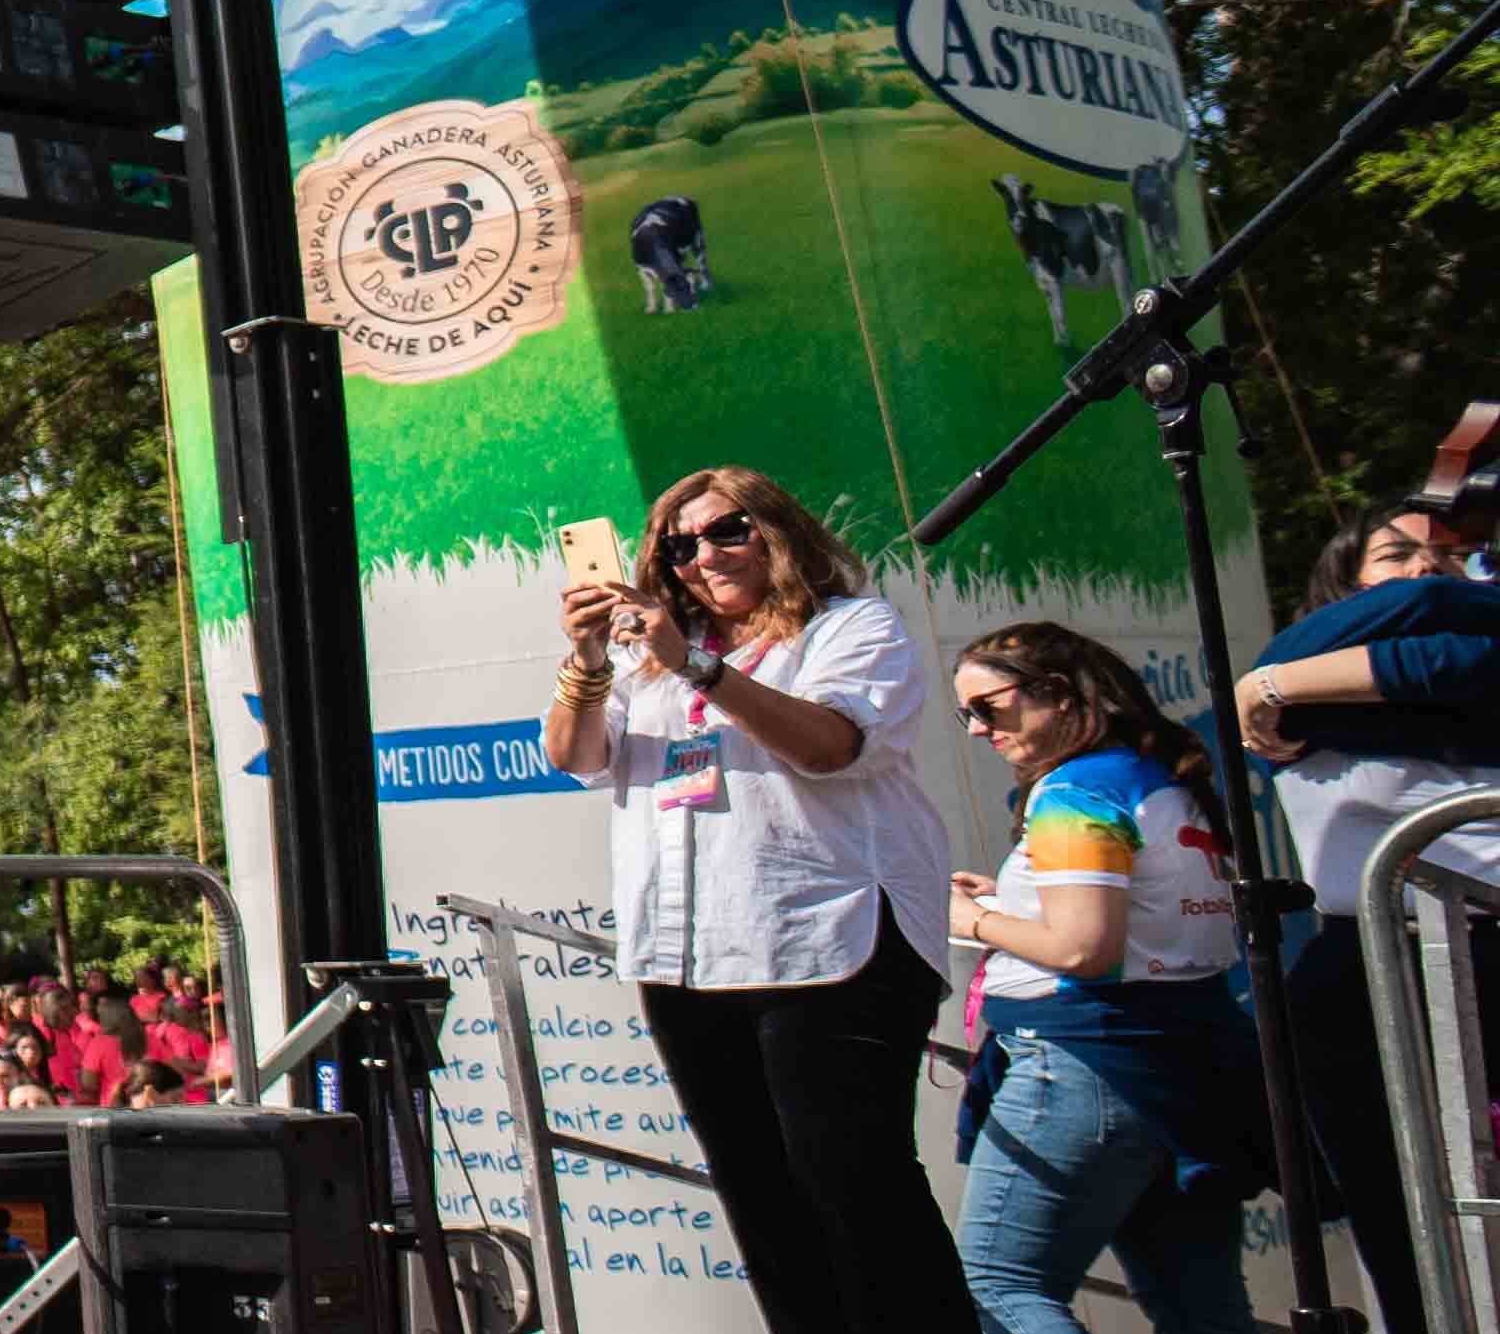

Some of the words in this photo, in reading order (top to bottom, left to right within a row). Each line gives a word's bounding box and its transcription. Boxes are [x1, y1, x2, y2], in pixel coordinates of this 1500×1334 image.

[307, 170, 357, 305] AGRUPACIÓN
[361, 126, 490, 169] GANADERA
[493, 142, 557, 253] ASTURIANA
[360, 269, 436, 314] Desde
[442, 246, 501, 305] 1970
[341, 313, 420, 356] LECHE
[428, 326, 466, 354] DE
[473, 277, 534, 339] AQUÍ
[492, 738, 550, 782] CON
[531, 1005, 614, 1039] alcio
[587, 1201, 712, 1232] aporte
[605, 1251, 647, 1276] en
[657, 1242, 689, 1280] la
